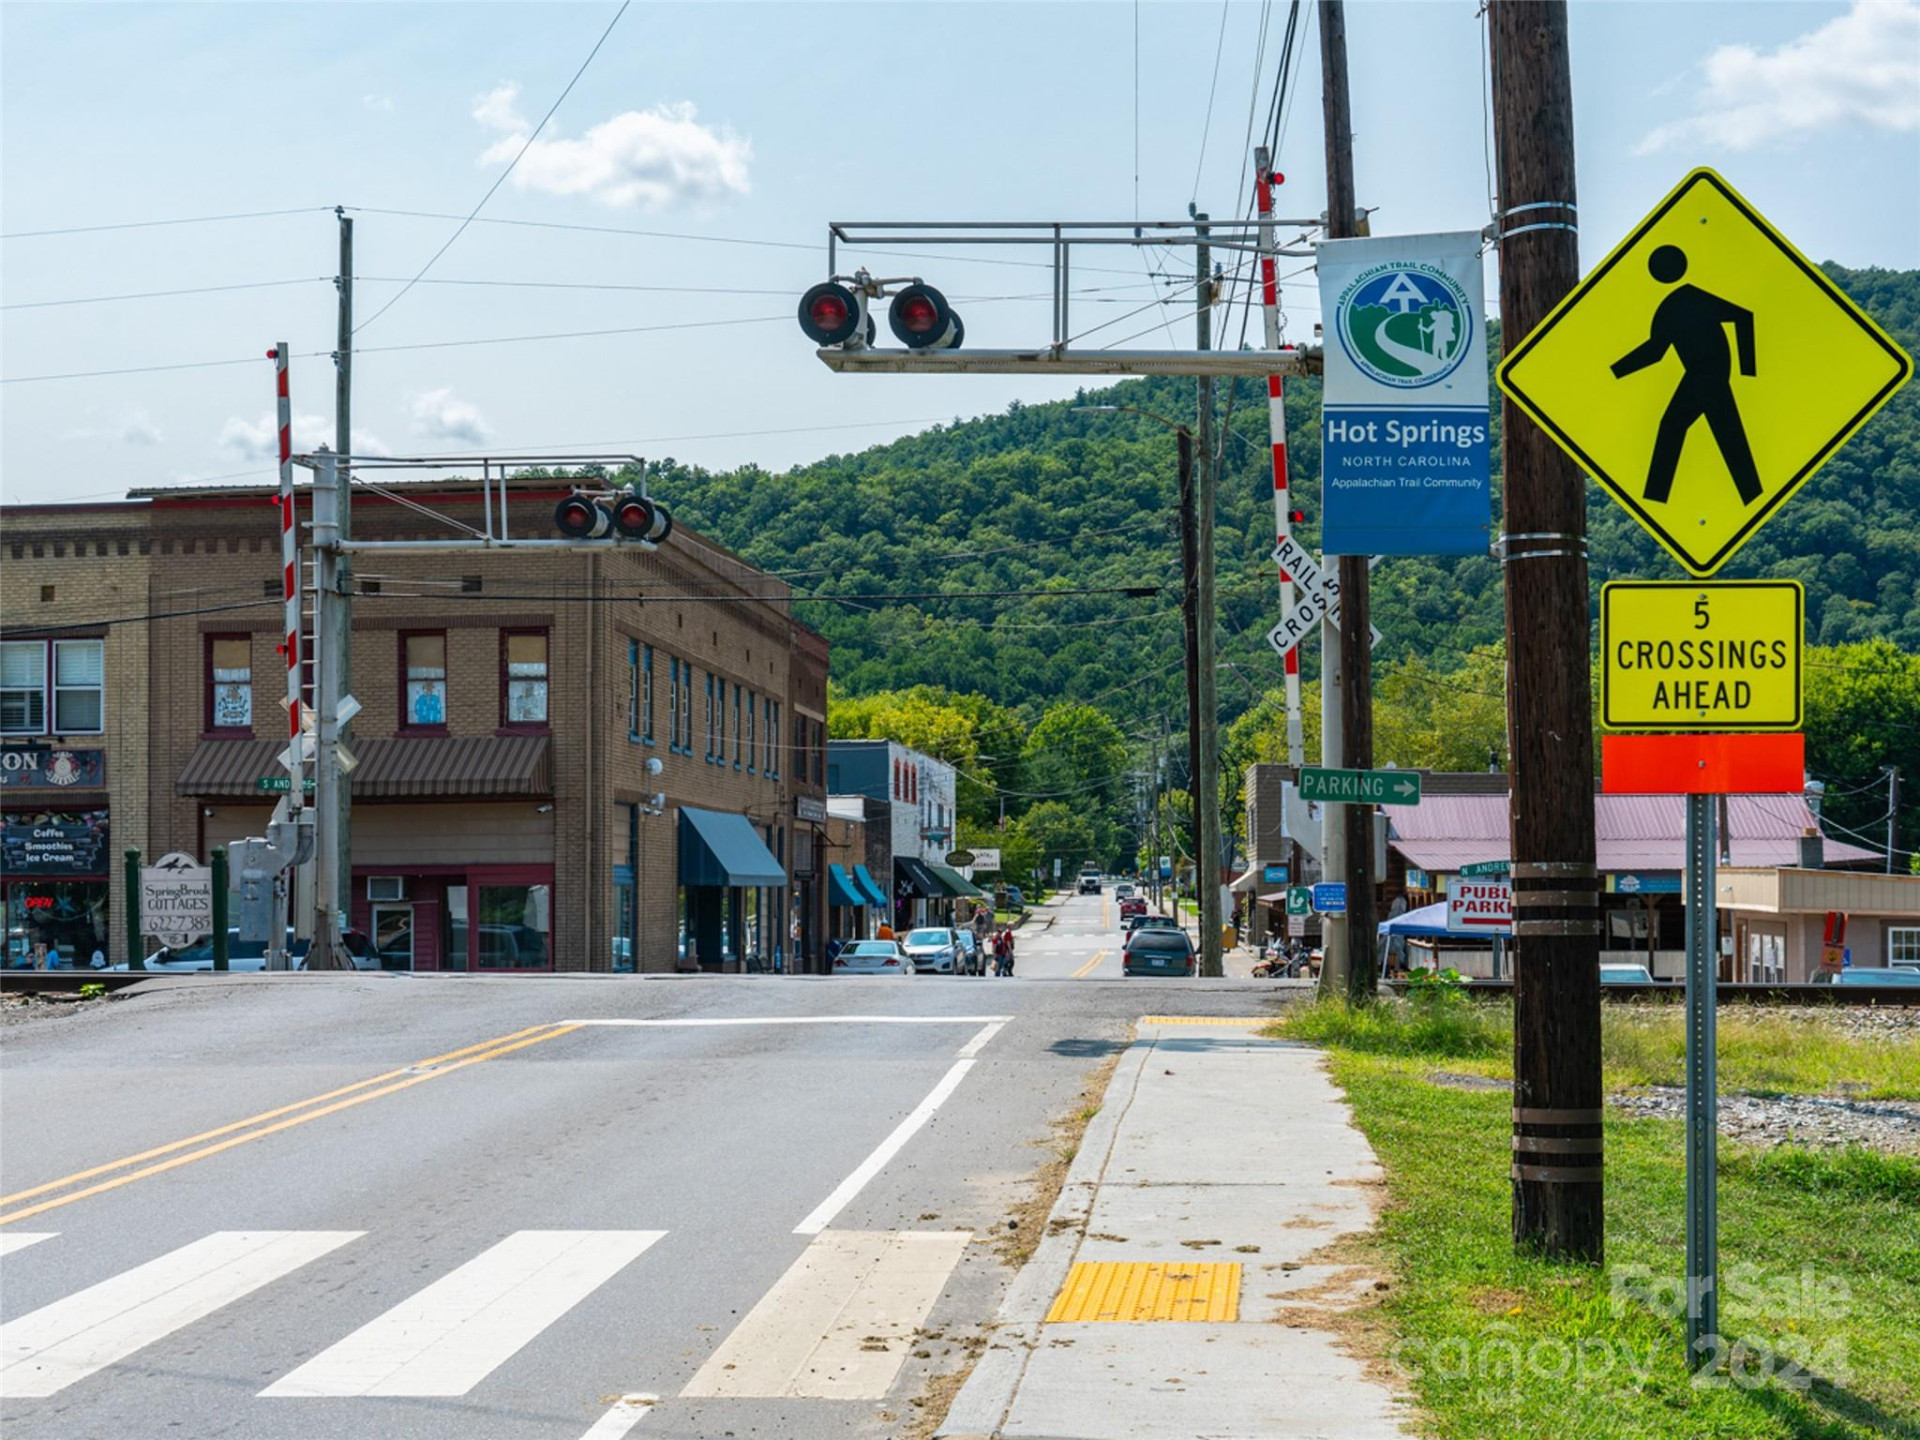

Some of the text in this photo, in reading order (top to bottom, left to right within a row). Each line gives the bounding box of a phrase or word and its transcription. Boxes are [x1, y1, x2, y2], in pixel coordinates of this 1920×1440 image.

[1390, 262, 1417, 270] TRAIL
[1420, 263, 1470, 305] COMMUNITY
[1328, 420, 1485, 448] Hot Springs
[1342, 456, 1471, 467] NORTH CAROLINA
[1331, 477, 1482, 490] Appalachian Trail Community
[1694, 601, 1710, 629] 5
[1618, 640, 1787, 669] CROSSINGS
[1652, 681, 1751, 709] AHEAD
[0, 752, 38, 771] ON
[1303, 775, 1384, 796] PARKING
[33, 828, 65, 838] Coffee
[24, 842, 74, 851] Smoothies
[26, 853, 75, 863] Ice Cream
[1462, 867, 1469, 876] N
[24, 896, 54, 909] OPEN
[148, 898, 208, 910] COTTAGES
